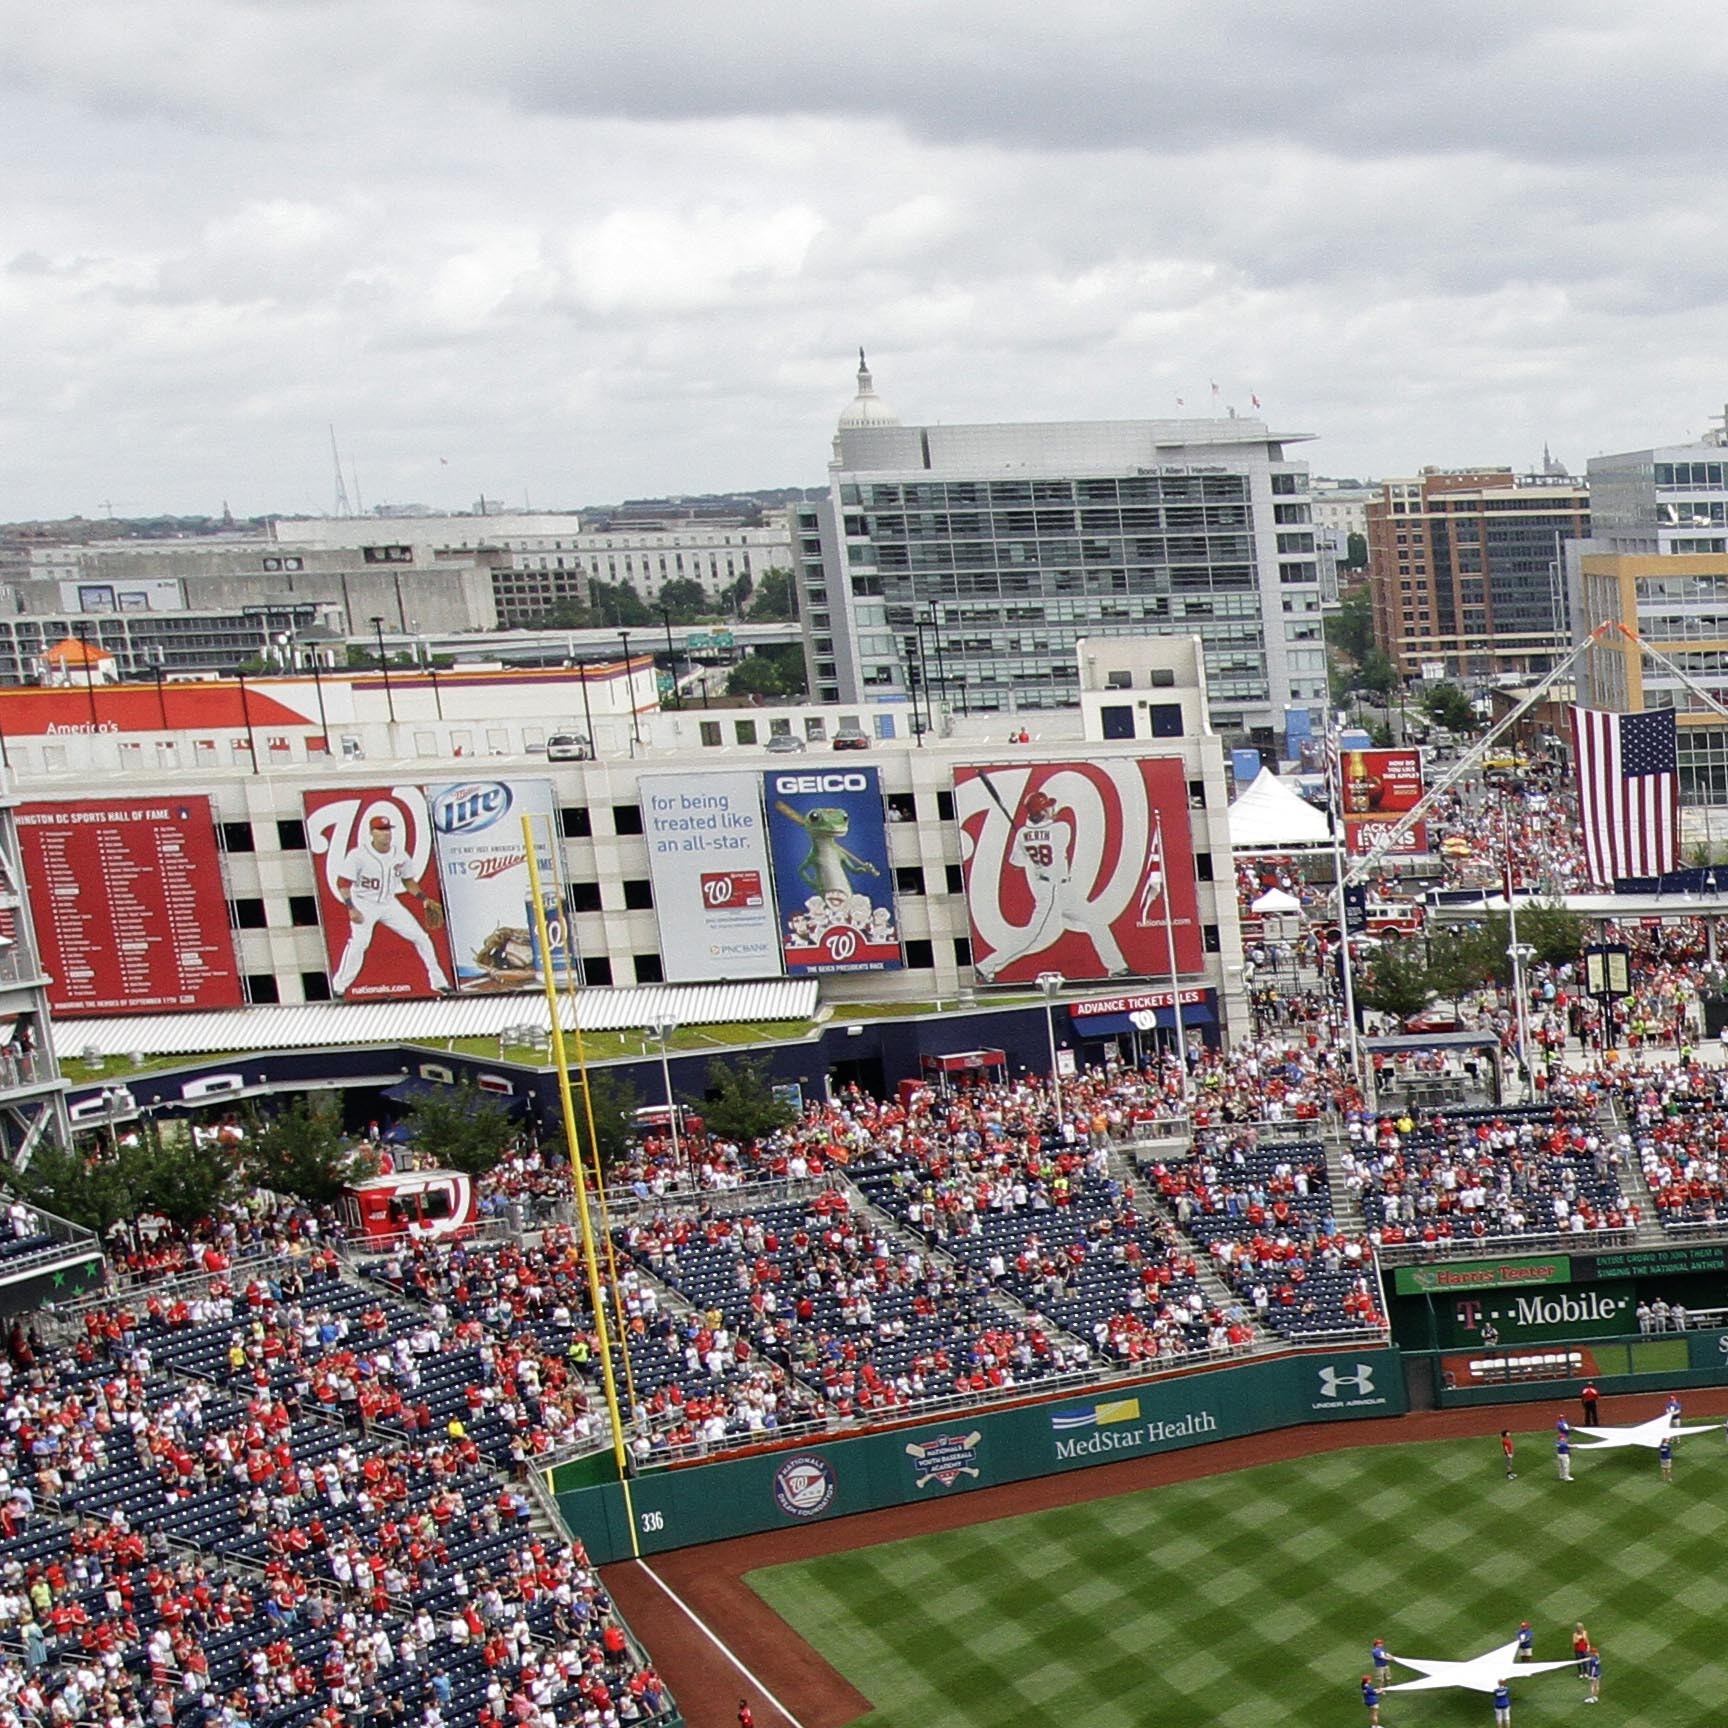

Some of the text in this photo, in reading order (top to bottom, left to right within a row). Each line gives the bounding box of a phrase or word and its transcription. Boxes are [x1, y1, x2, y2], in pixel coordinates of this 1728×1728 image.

[776, 773, 867, 794] GEICO
[652, 794, 729, 811] for being
[56, 813, 69, 824] DC
[71, 812, 106, 824] SPORTS
[108, 811, 131, 822] HALL
[132, 810, 144, 821] OF
[146, 809, 170, 820] FAME
[654, 813, 753, 832] treated like
[657, 835, 751, 852] an all-star.
[360, 876, 380, 890] 20
[350, 983, 411, 995] nationals.com
[1077, 992, 1199, 1015] ADVANCE TICKET SLES
[1436, 1267, 1494, 1285] Harris
[1500, 1264, 1557, 1281] Teeter
[1516, 1291, 1616, 1326] Mobile
[1056, 1411, 1218, 1461] MedStar Health
[781, 1457, 825, 1478] NATIONALS
[641, 1511, 664, 1533] 336
